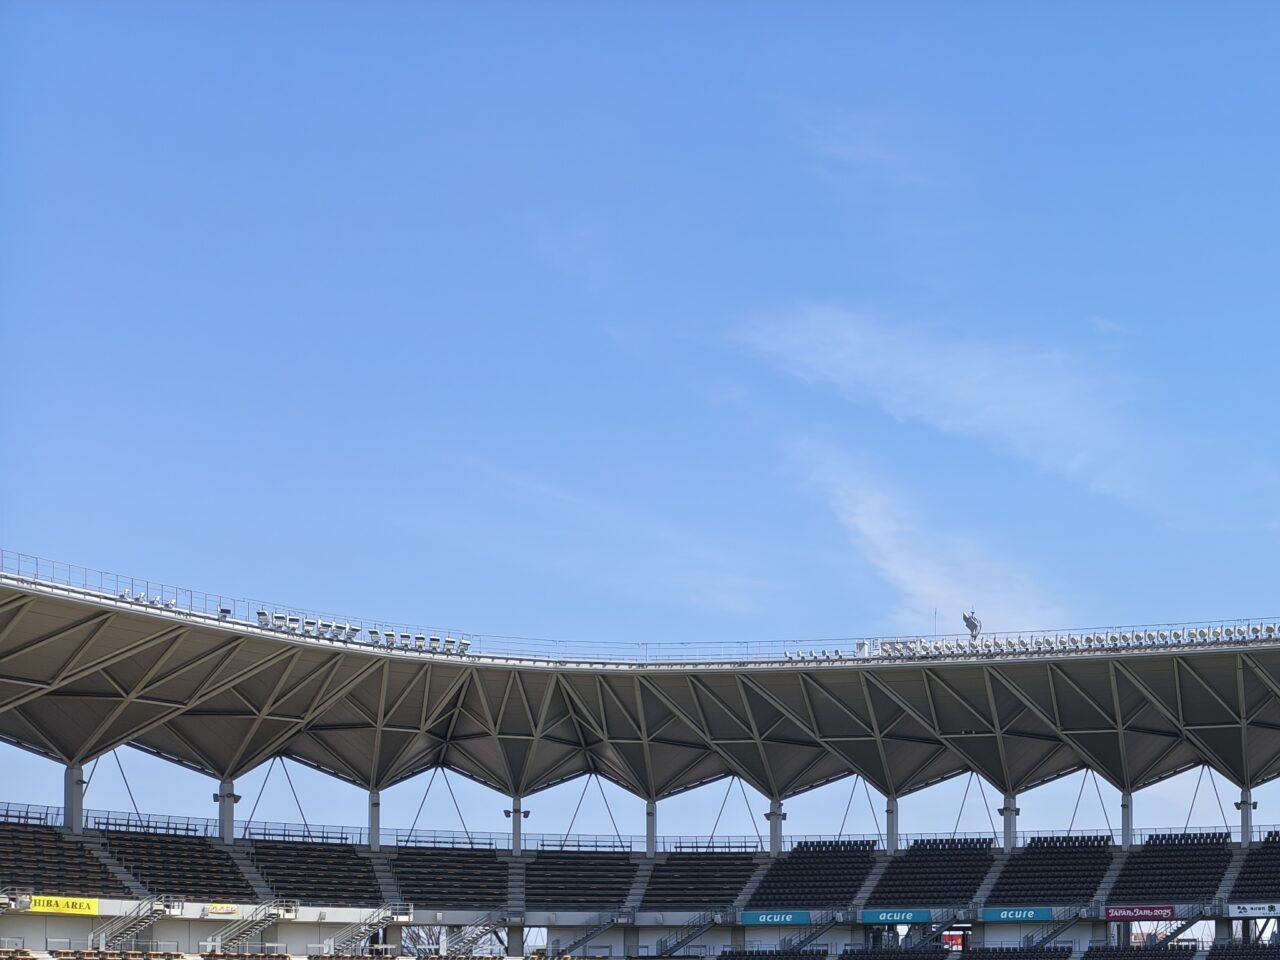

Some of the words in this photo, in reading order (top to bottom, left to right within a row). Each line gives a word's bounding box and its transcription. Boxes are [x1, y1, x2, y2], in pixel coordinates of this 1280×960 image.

[33, 900, 59, 908] HIBA
[64, 901, 91, 910] AREA
[759, 912, 793, 922] acure
[879, 910, 913, 921] acure
[1000, 908, 1035, 919] acure
[1153, 909, 1172, 918] 2025
